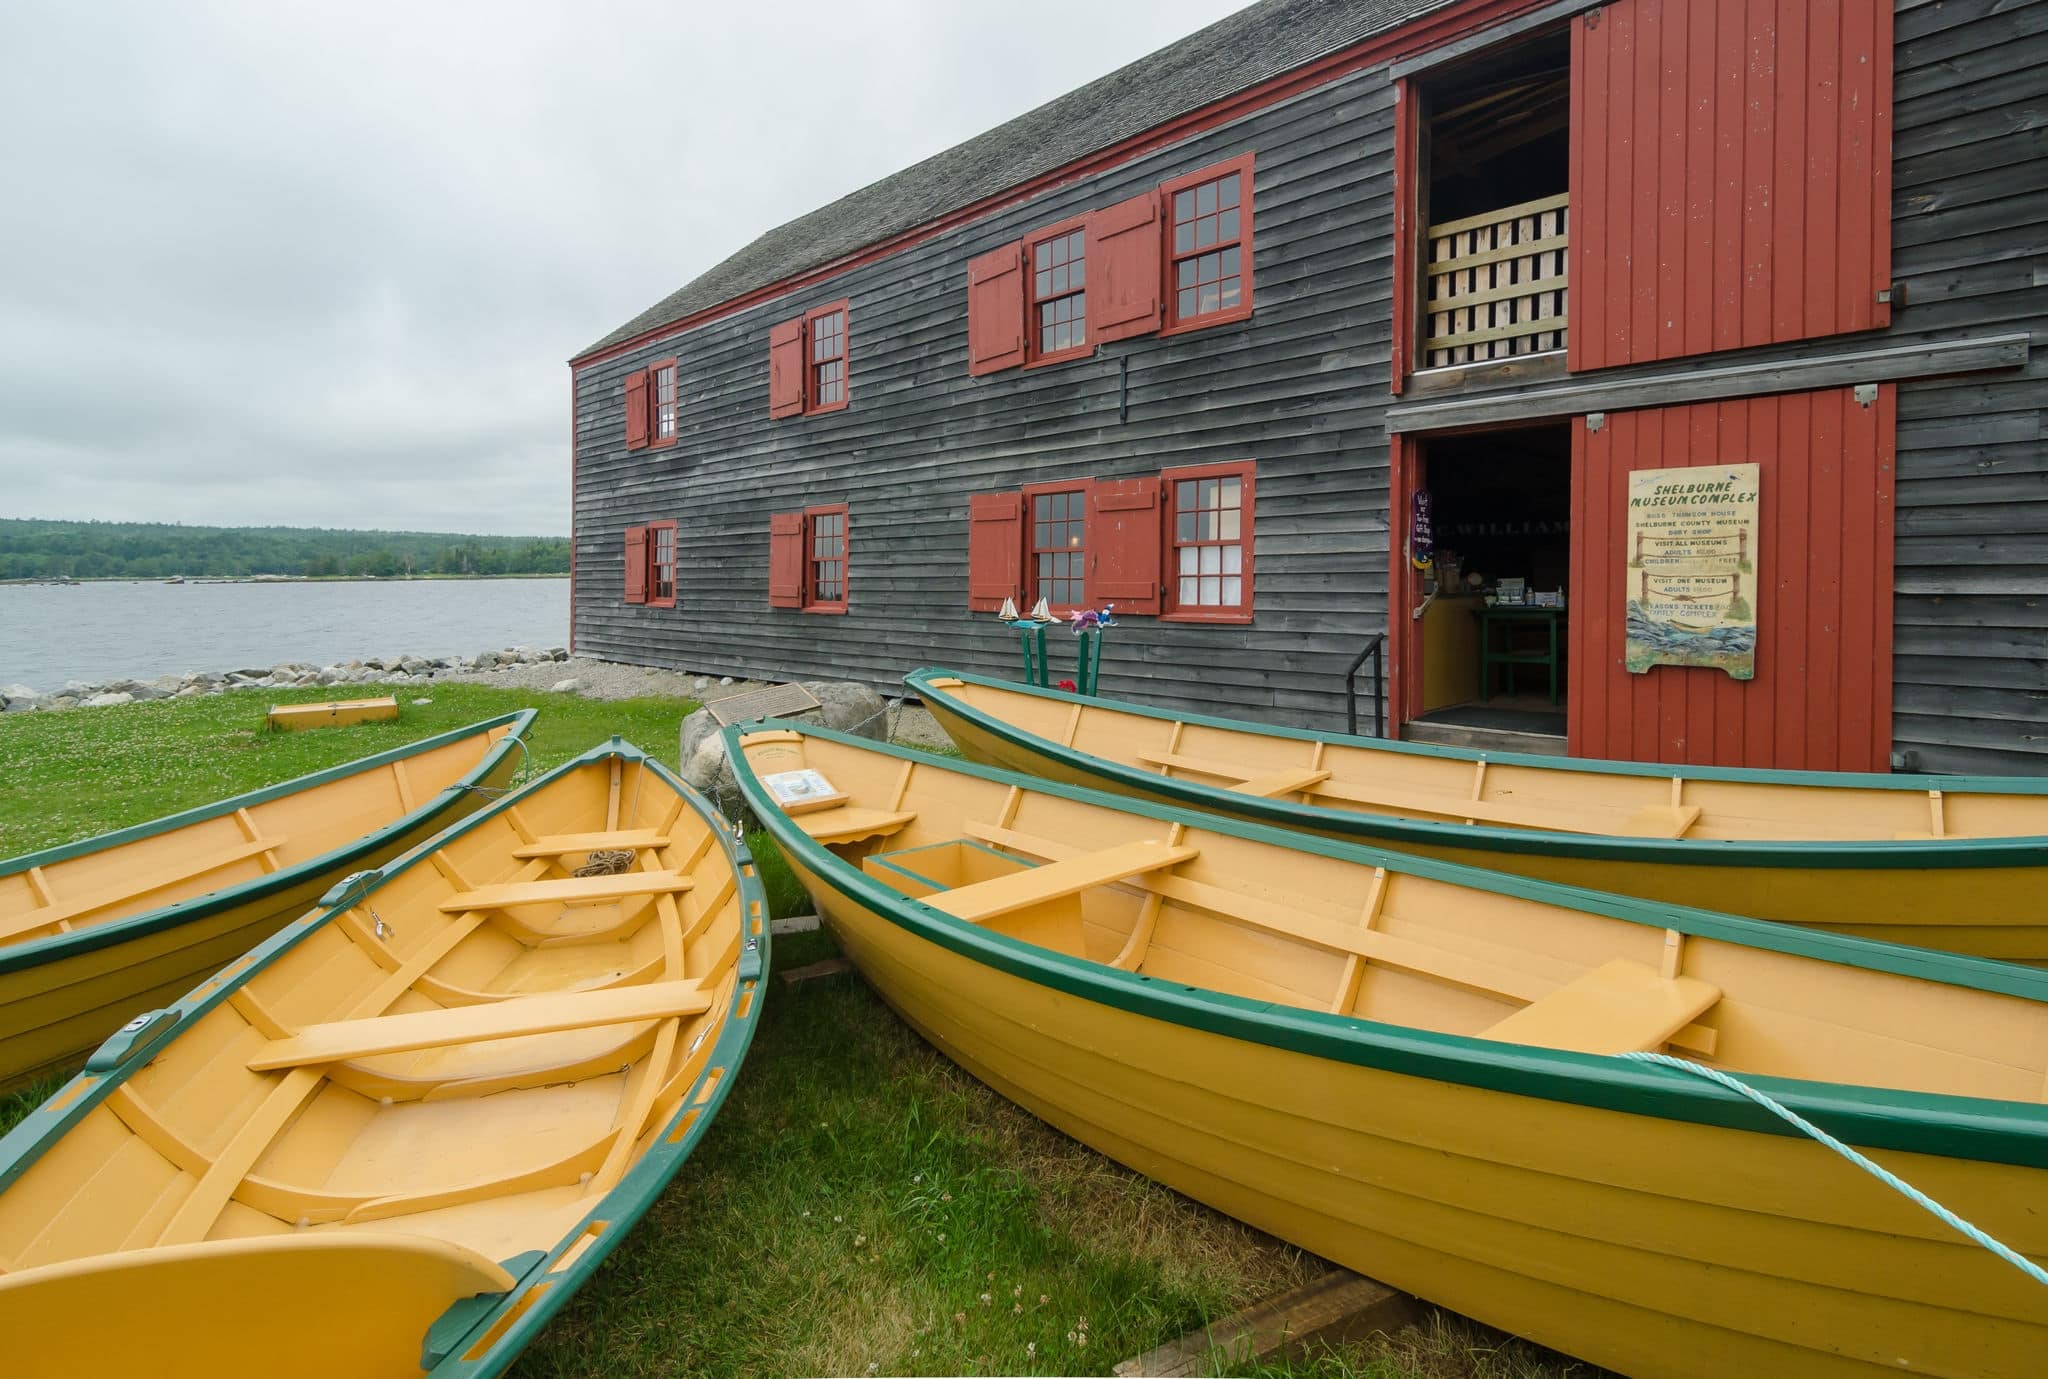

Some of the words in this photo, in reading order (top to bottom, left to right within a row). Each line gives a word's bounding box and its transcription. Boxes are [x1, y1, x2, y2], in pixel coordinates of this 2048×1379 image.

[1654, 481, 1733, 495] SHELBURNE
[1630, 495, 1688, 508] MUSEUM
[1690, 492, 1757, 505] COMPLEX
